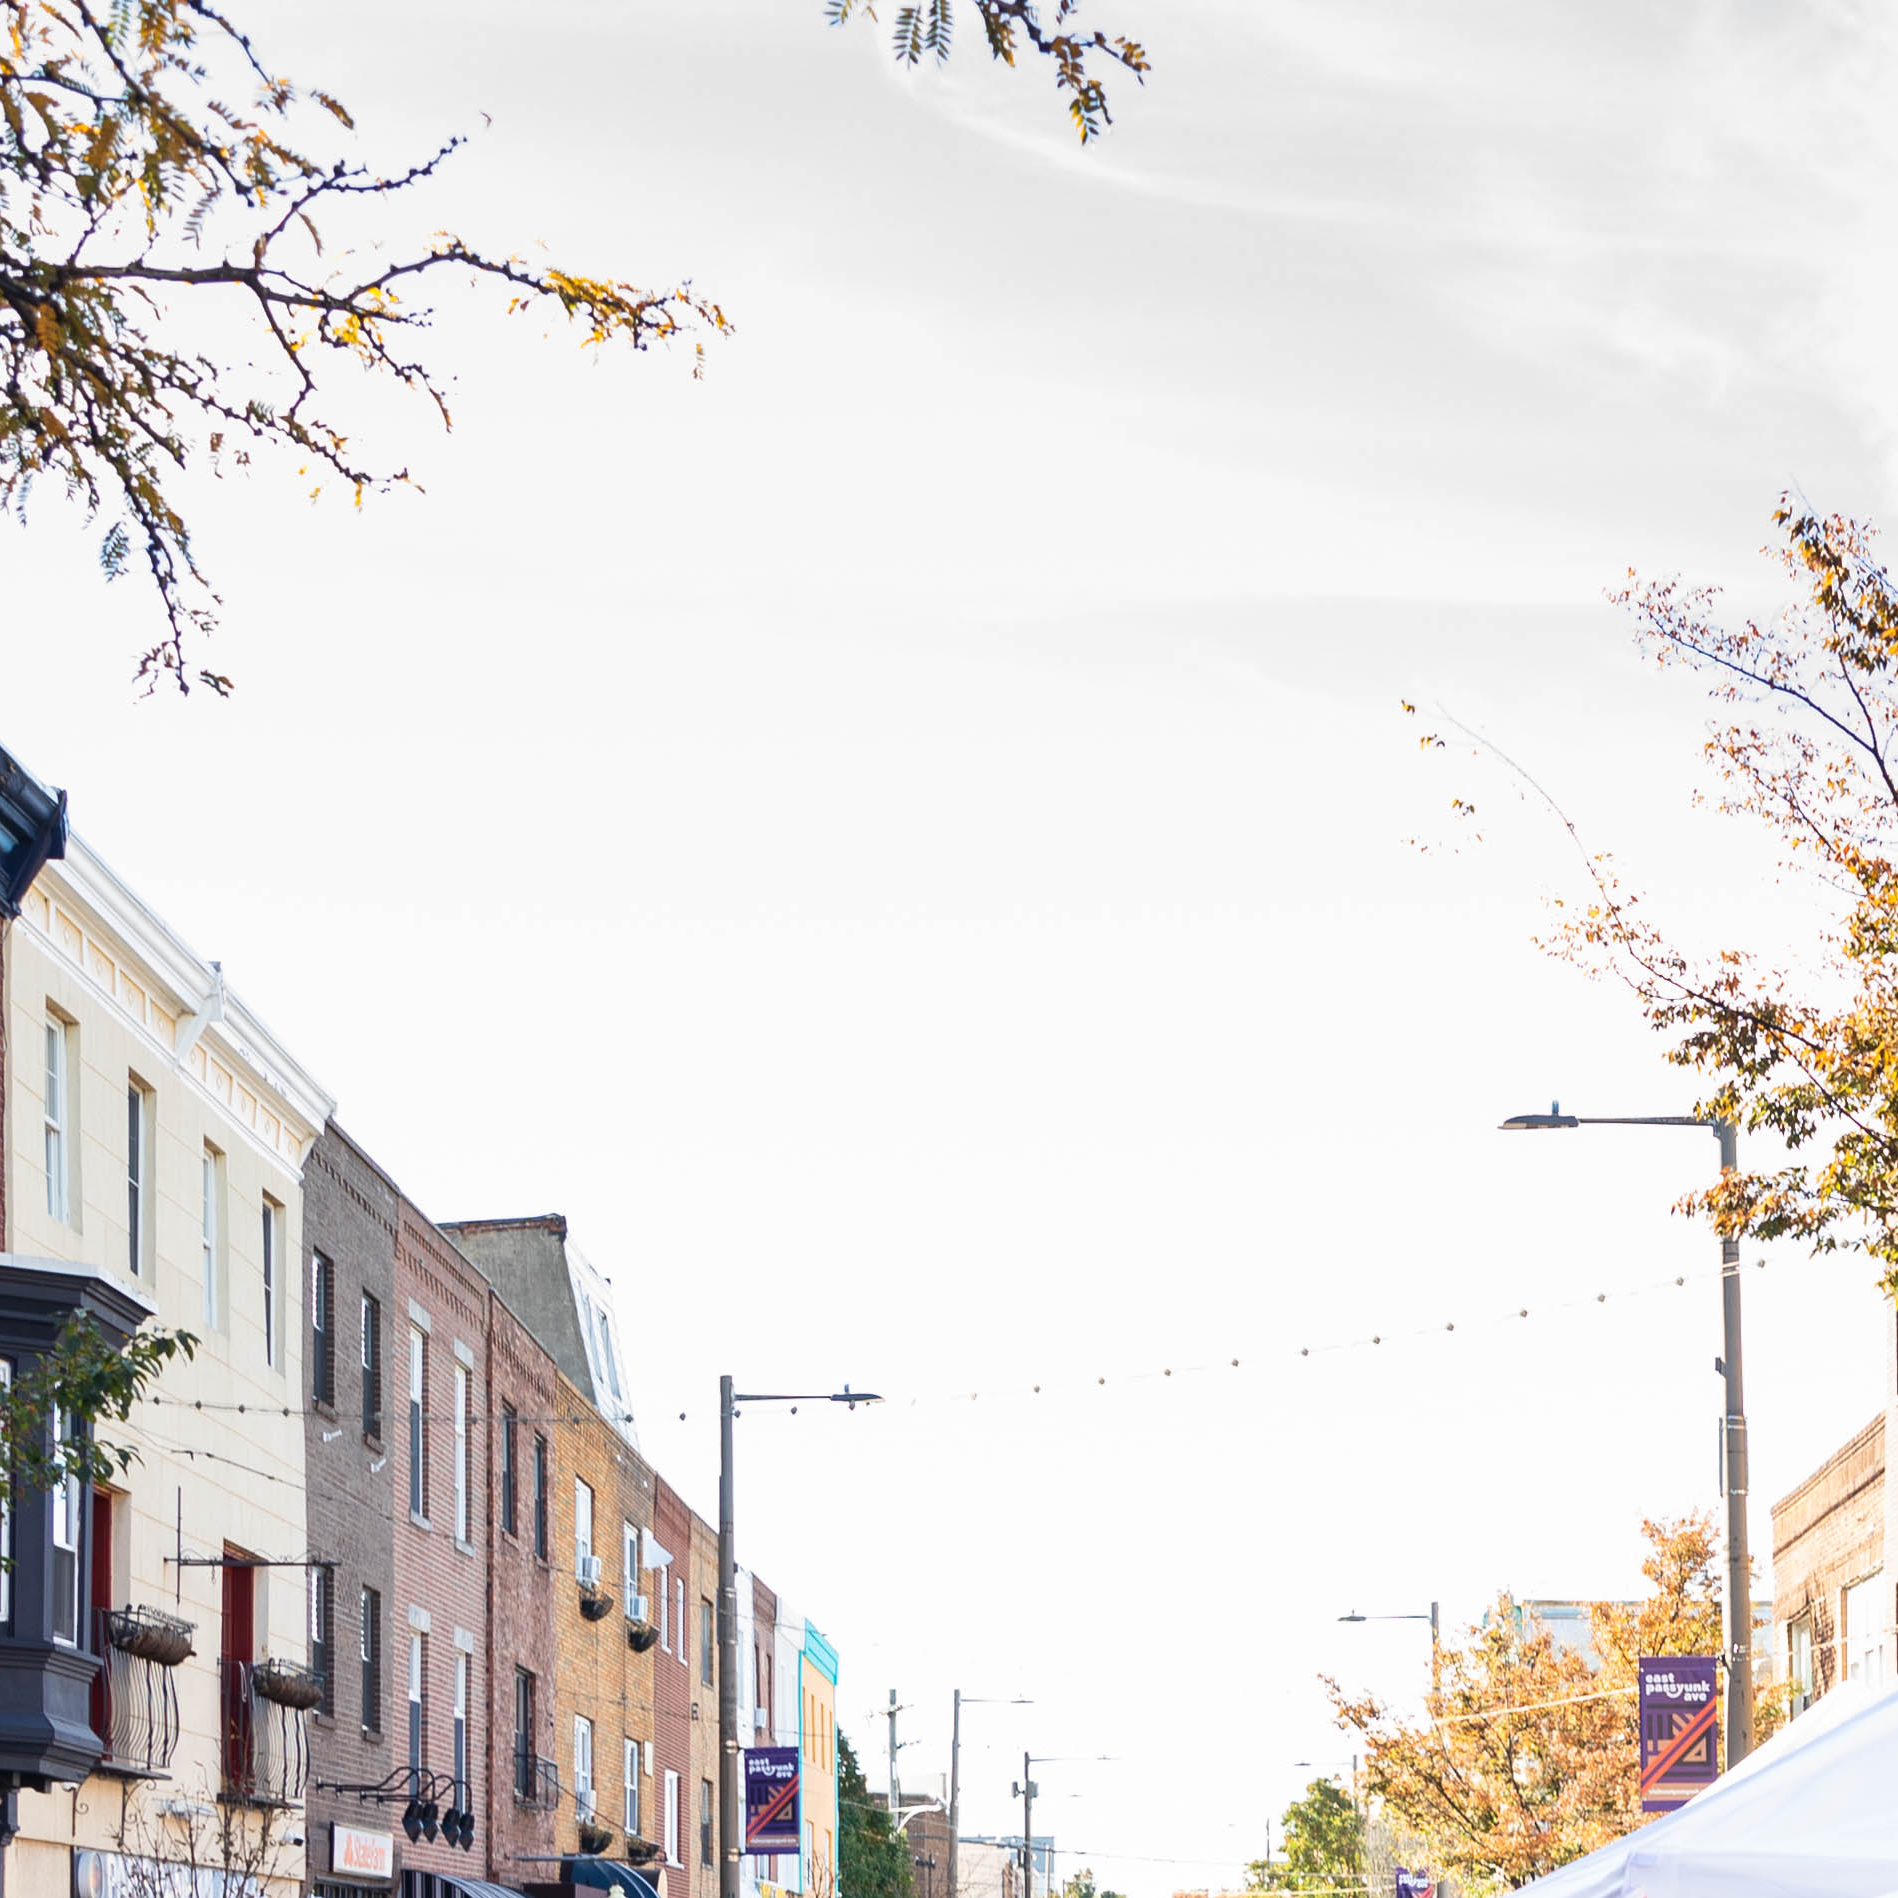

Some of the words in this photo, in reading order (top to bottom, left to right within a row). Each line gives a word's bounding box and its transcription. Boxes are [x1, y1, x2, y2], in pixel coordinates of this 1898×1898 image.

[1645, 1673, 1675, 1685] east
[1645, 1680, 1711, 1699] passyunk
[1683, 1692, 1707, 1702] ave
[748, 1757, 770, 1766] east
[748, 1762, 795, 1777] passyunk
[775, 1770, 793, 1778] ave
